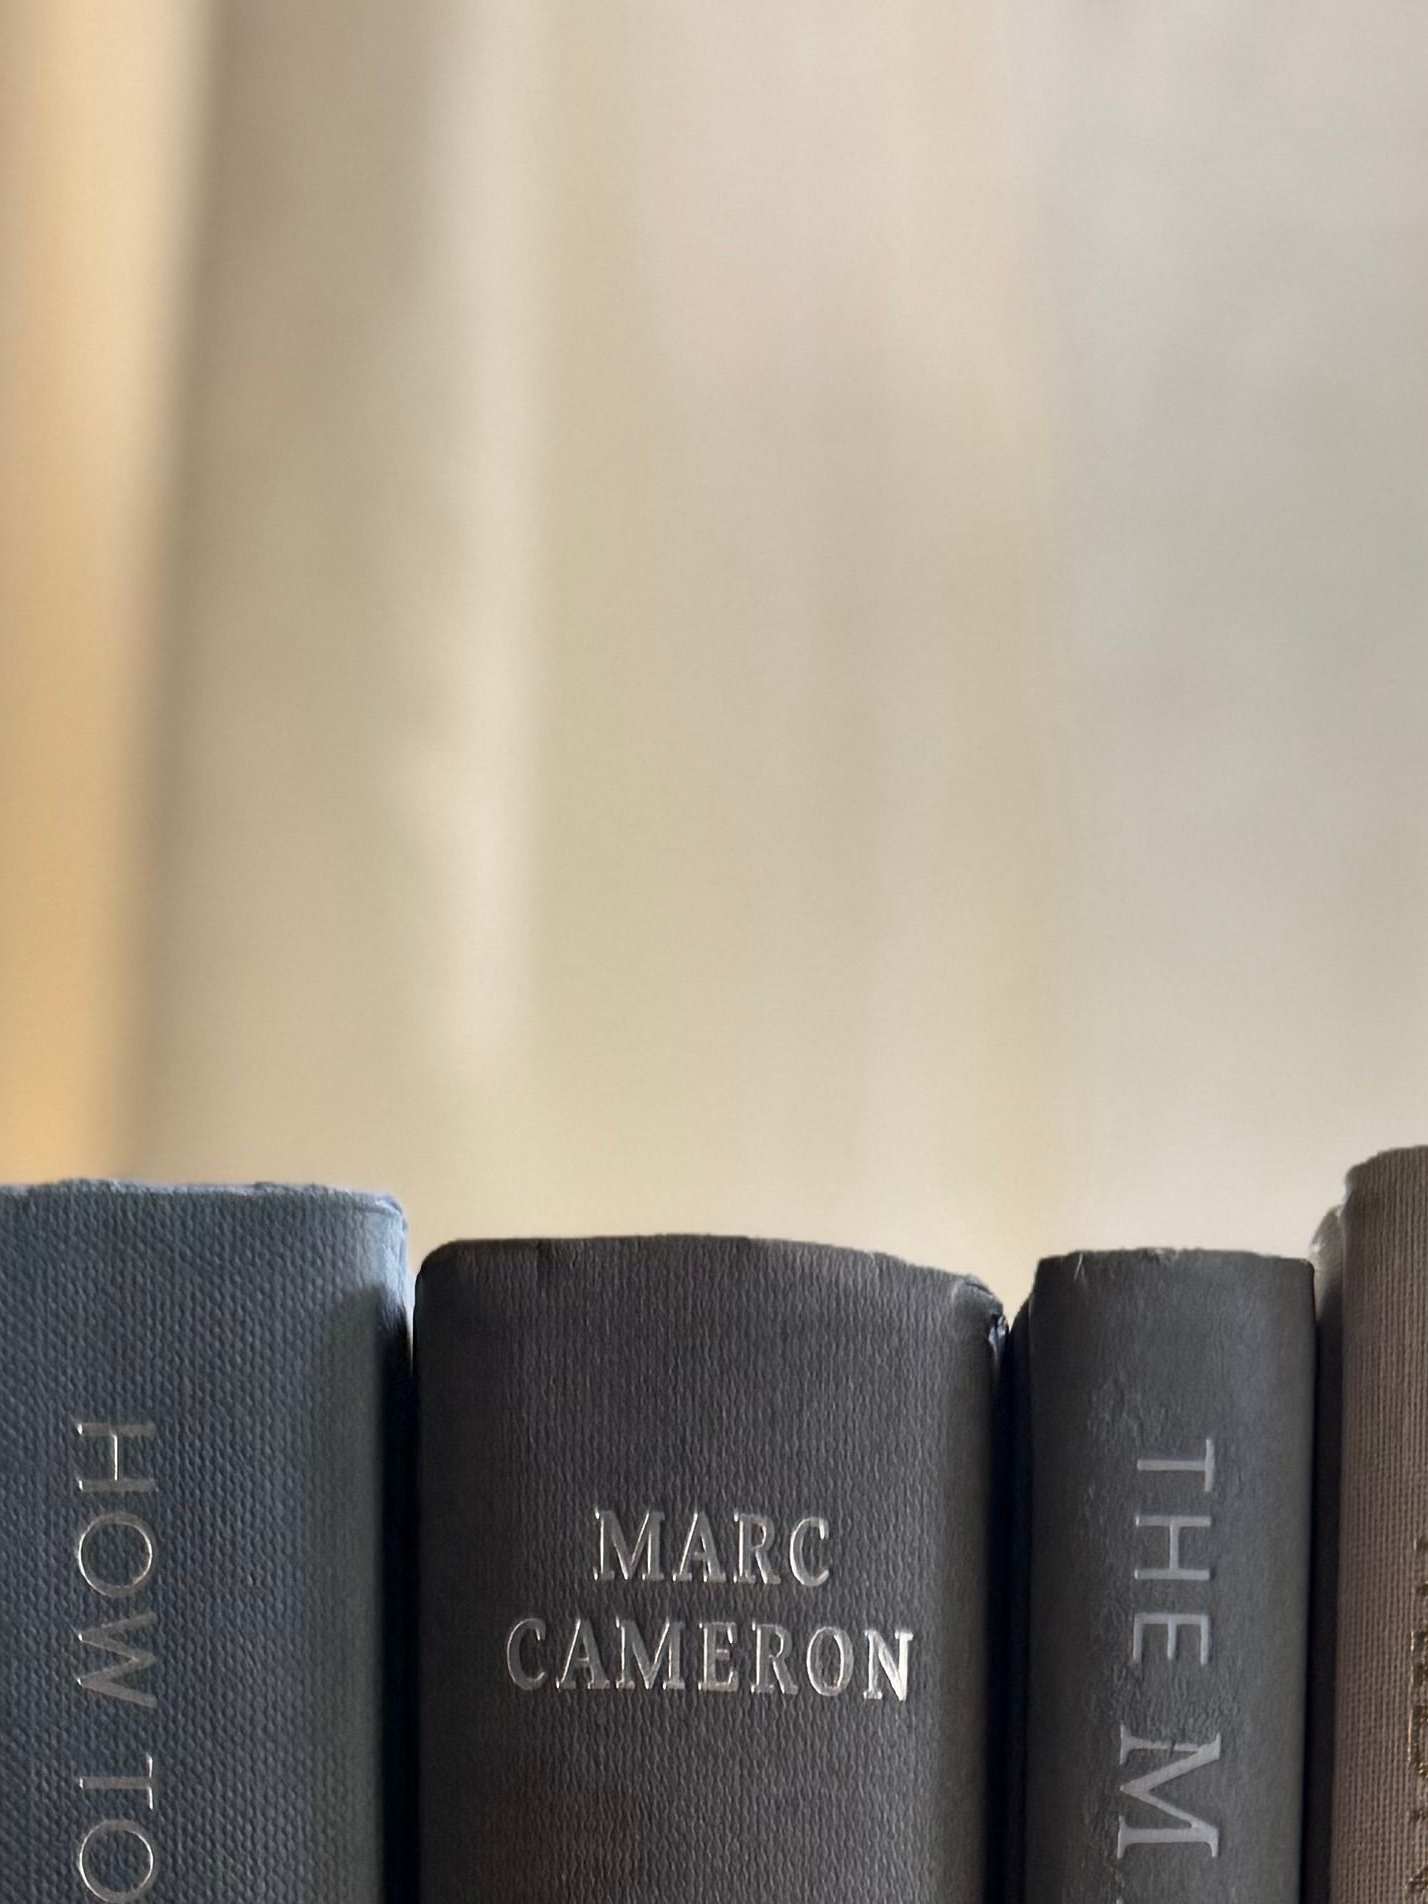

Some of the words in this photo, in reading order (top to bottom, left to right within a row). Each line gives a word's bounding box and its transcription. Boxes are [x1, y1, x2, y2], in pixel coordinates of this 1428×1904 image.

[74, 1419, 160, 1710] HOW
[591, 1506, 832, 1587] MARC
[1132, 1437, 1217, 1667] THE
[504, 1615, 915, 1703] CAMERON
[76, 1755, 156, 1904] TO
